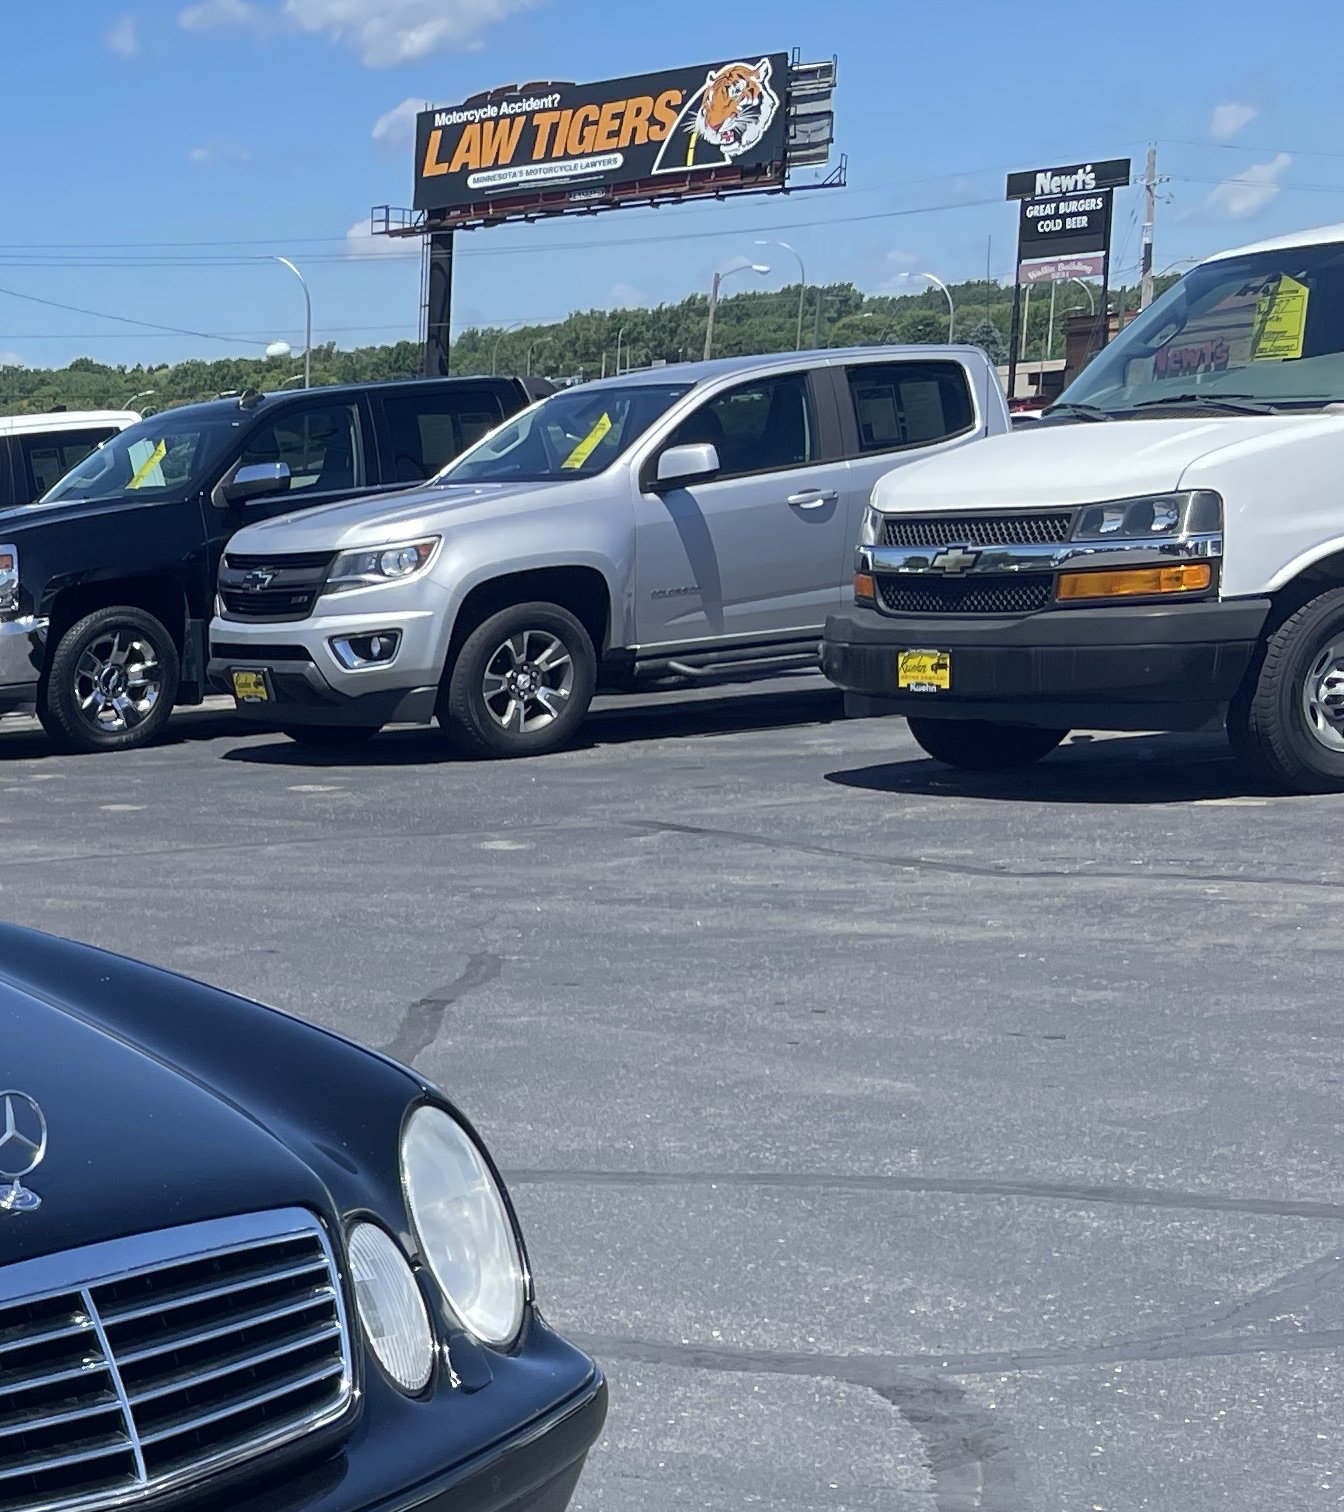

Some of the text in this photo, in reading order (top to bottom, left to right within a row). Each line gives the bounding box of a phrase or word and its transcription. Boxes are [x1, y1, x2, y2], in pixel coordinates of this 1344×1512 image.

[434, 93, 561, 127] Motorcycle Accident?
[422, 89, 682, 177] LAW TIGERS
[472, 156, 618, 184] MINNESOTA'S MOTORCYCLE LAWYERS
[1035, 165, 1096, 195] Newt's
[1025, 197, 1103, 218] GREAT BURGERS
[1037, 215, 1088, 233] COLD BEER
